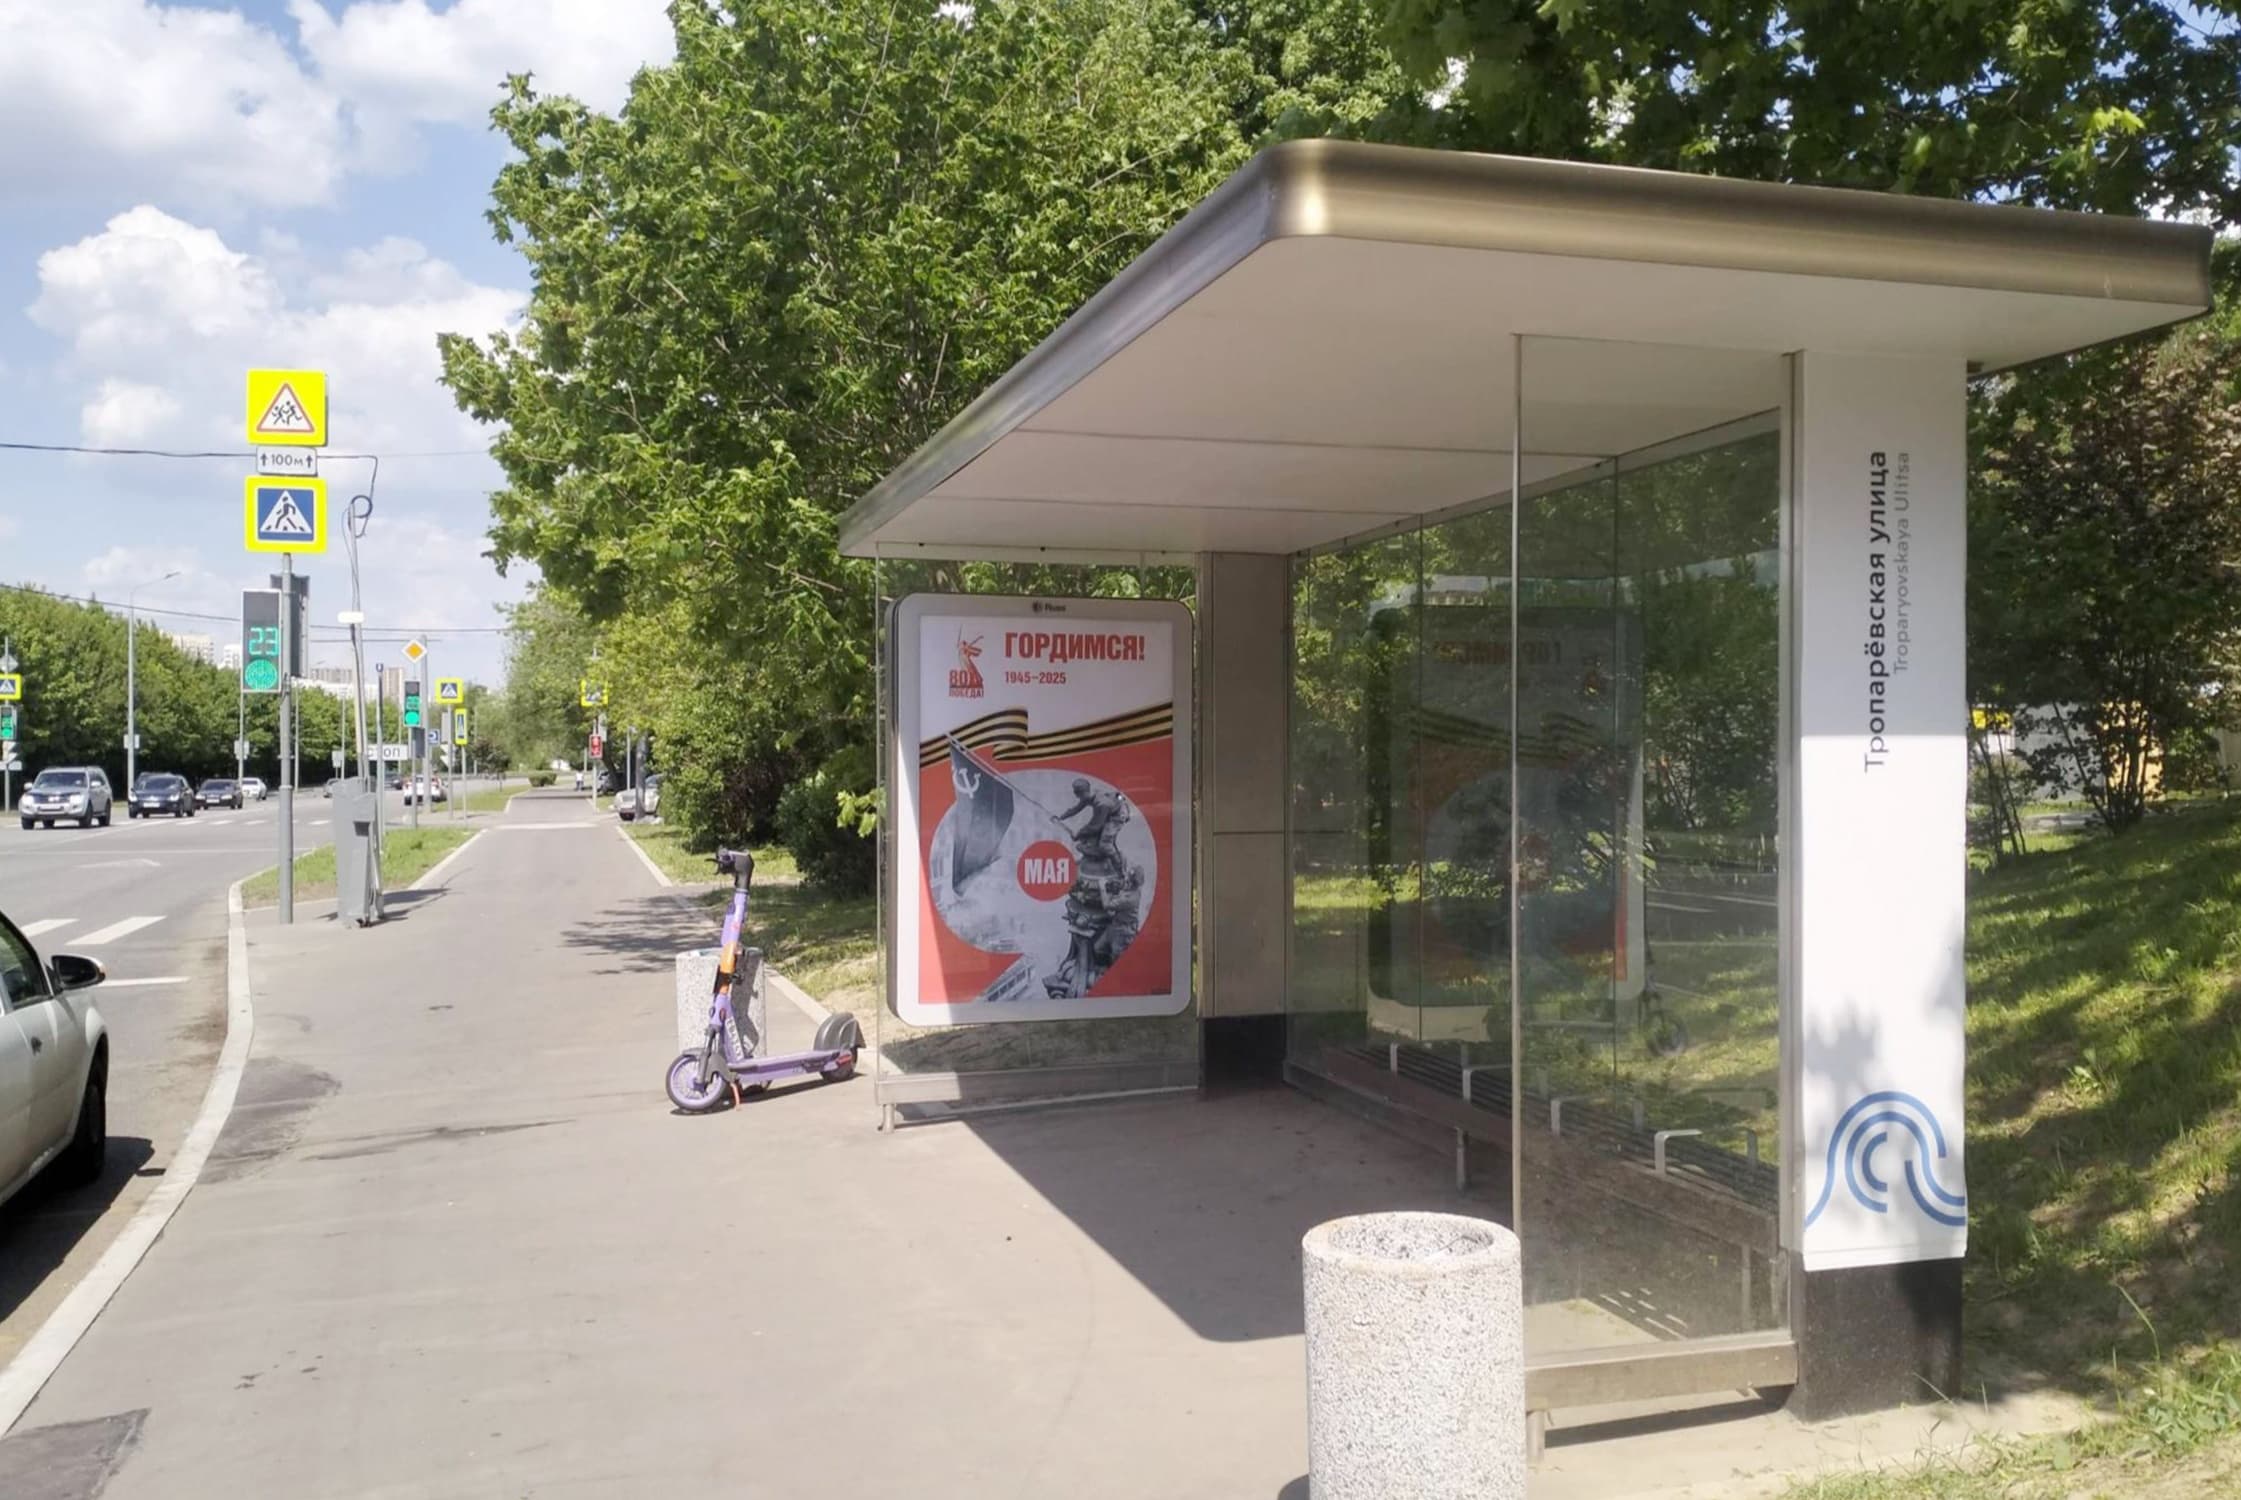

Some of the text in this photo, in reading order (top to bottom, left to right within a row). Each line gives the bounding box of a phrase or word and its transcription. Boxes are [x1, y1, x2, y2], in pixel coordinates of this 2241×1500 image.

[1893, 451, 1912, 674] Troparyovskaya Ulitsa
[1864, 450, 1891, 773] Тропарёвская улица
[249, 626, 279, 656] 23
[1004, 631, 1146, 663] ГОРДИМСЯ!
[1024, 858, 1070, 884] МАЯ
